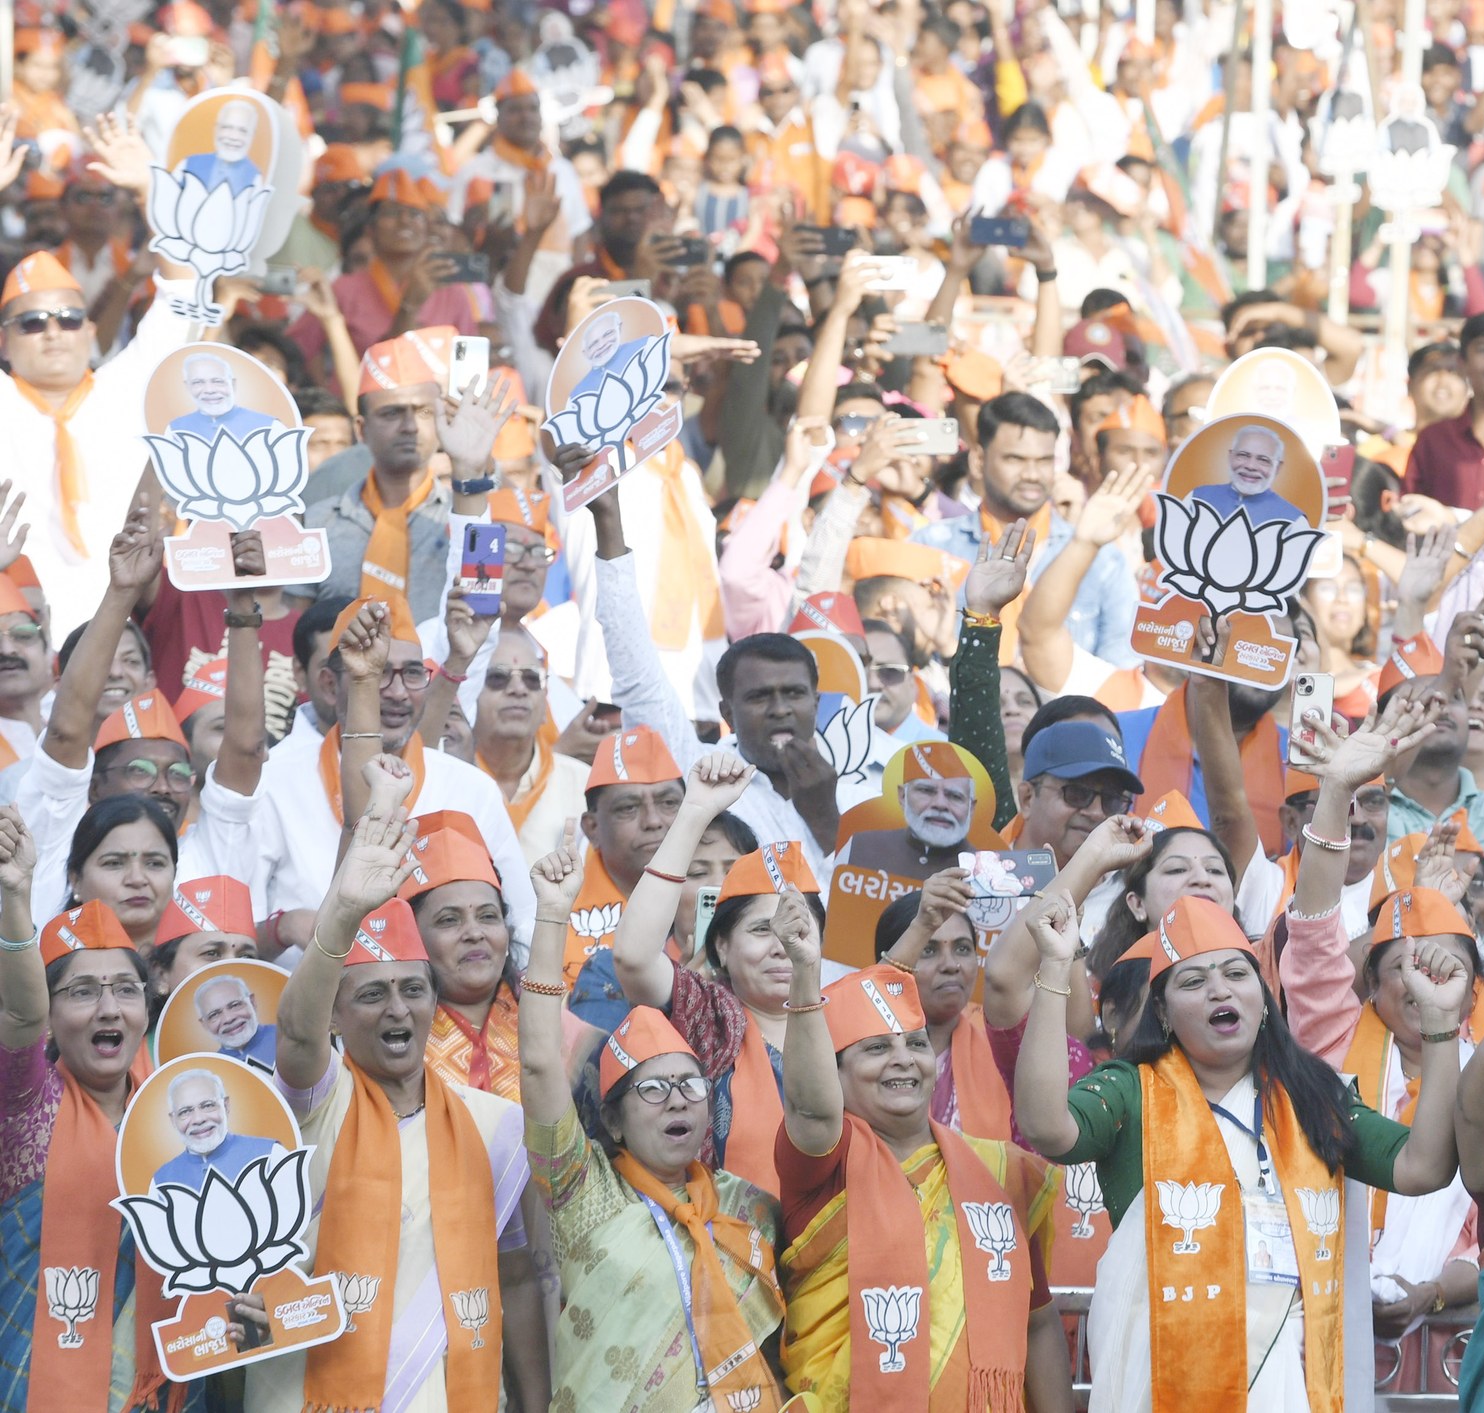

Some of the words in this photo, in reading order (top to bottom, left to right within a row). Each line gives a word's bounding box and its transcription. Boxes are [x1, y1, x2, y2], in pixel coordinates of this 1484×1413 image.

[489, 537, 499, 554] 4
[1137, 621, 1176, 636] ભરોસાની
[1157, 634, 1188, 649] ભાજપ
[839, 869, 922, 901] ભરોસ
[1162, 1284, 1222, 1303] BJP
[276, 1302, 301, 1317] ડબલ
[166, 1328, 207, 1354] ભરોસાની
[193, 1336, 228, 1357] ભાજપ
